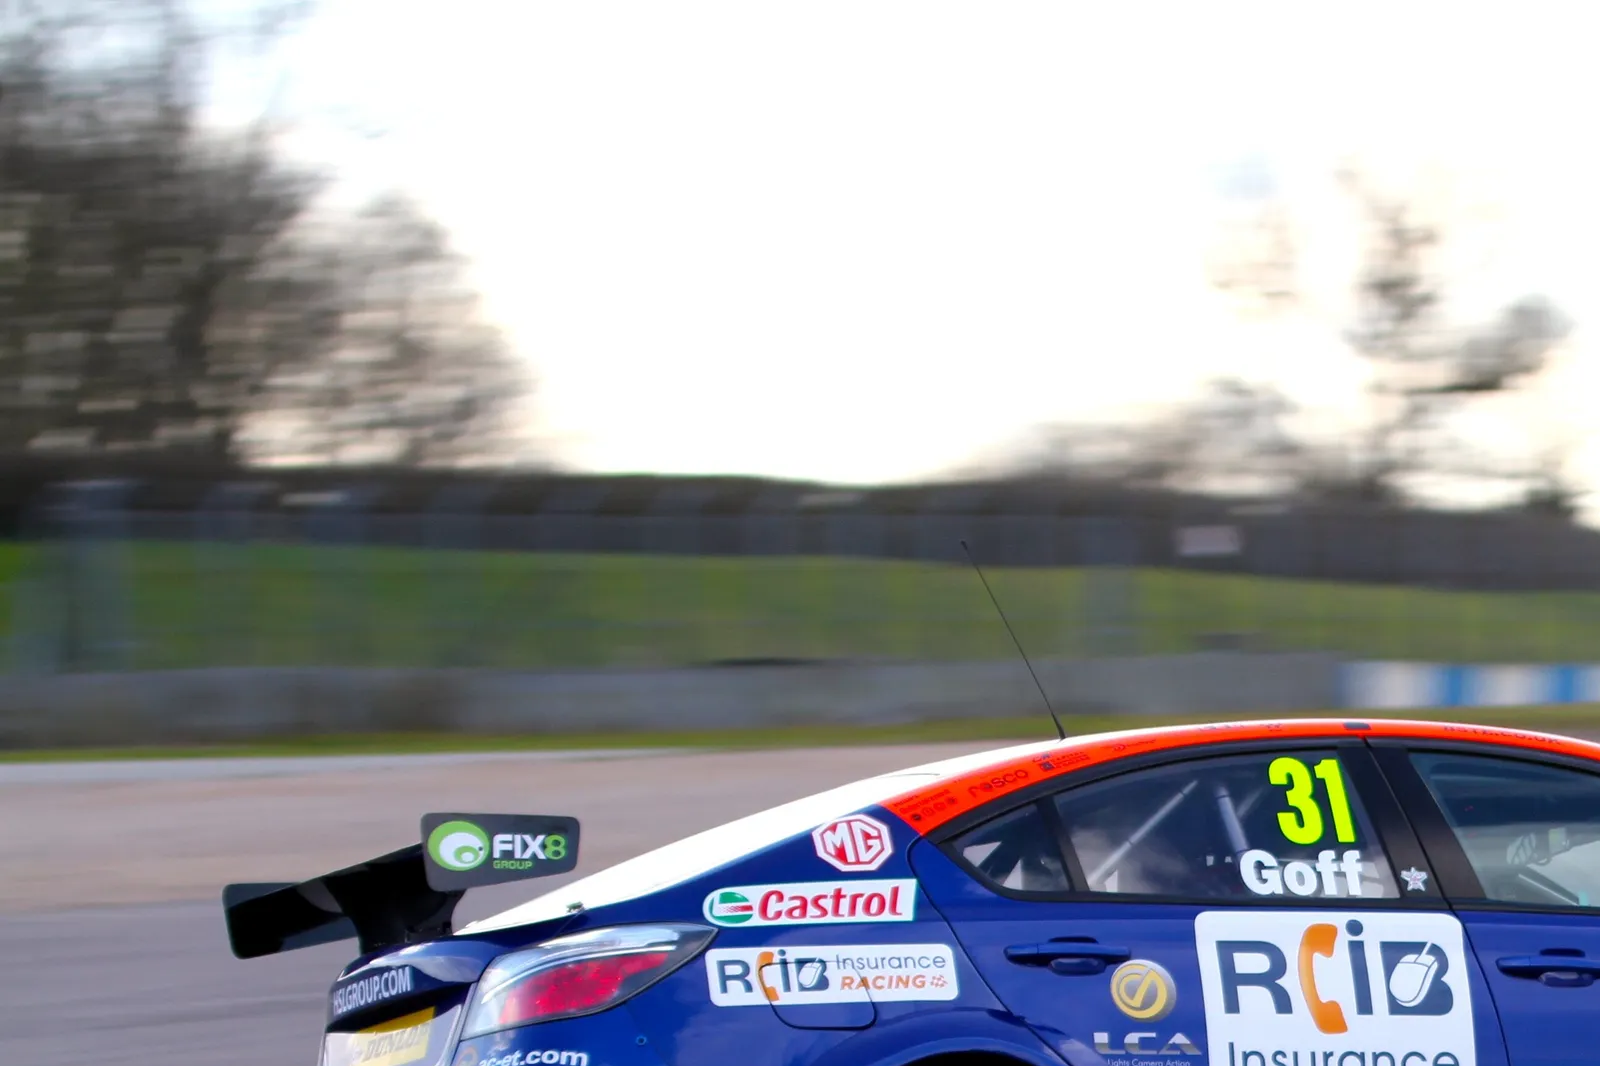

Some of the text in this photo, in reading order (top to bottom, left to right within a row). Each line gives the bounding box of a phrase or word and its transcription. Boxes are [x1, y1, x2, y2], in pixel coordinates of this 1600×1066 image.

[1268, 757, 1356, 844] 31
[493, 834, 566, 860] FIX8
[822, 820, 886, 865] MG
[493, 860, 533, 869] GROUP
[1239, 849, 1363, 896] Goff
[758, 886, 903, 921] Castrol
[836, 954, 946, 971] Insurance
[333, 966, 411, 1015] HSLGROUP.COM
[840, 974, 926, 991] RACING
[1093, 1032, 1202, 1055] LCA
